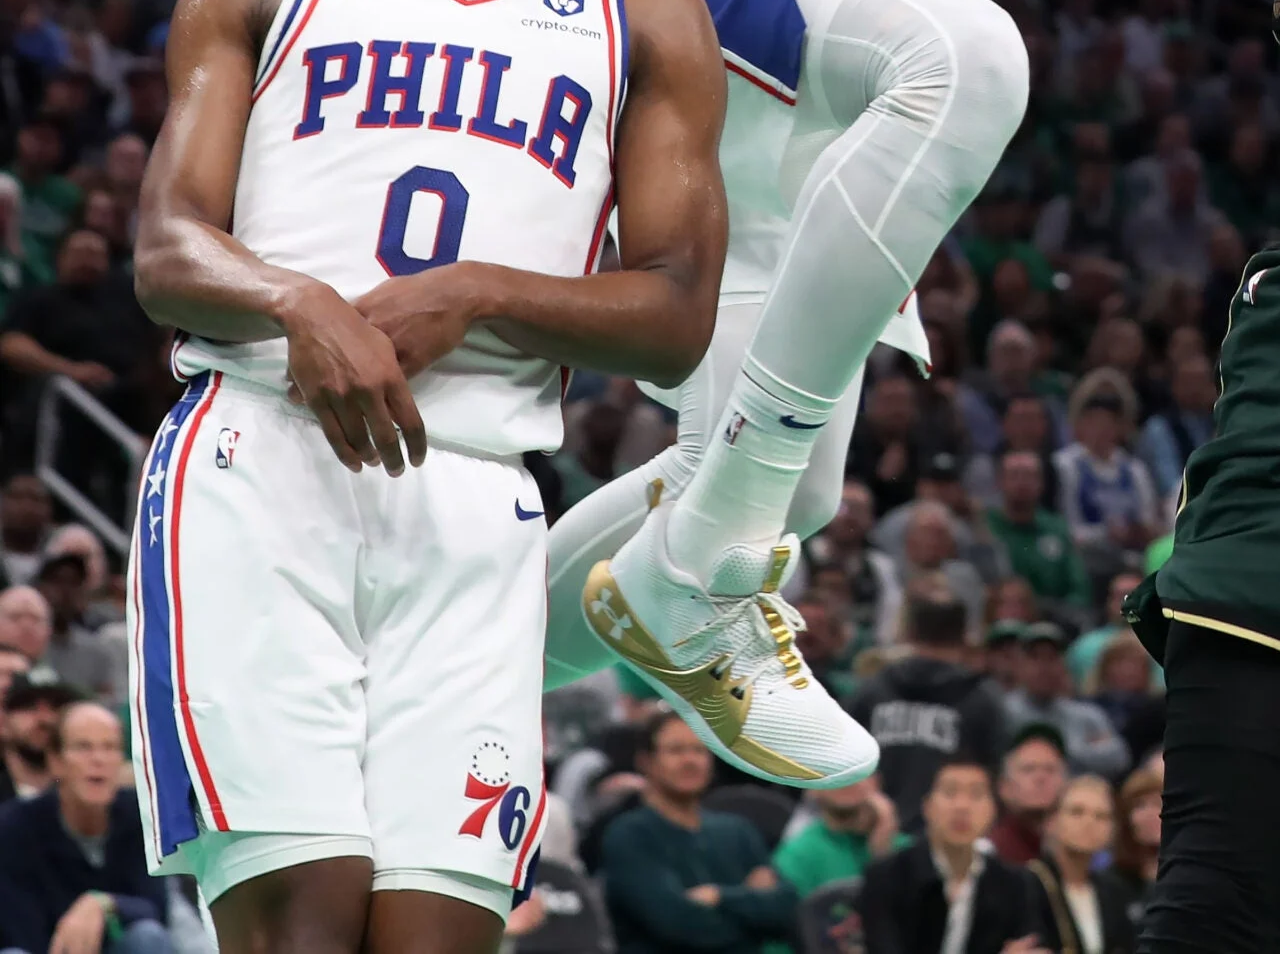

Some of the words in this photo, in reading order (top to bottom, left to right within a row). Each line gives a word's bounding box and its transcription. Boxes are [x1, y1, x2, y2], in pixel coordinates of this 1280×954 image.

[521, 17, 602, 40] crypto.com
[293, 40, 593, 189] PHILA
[375, 165, 470, 277] 0
[458, 772, 531, 850] 76
